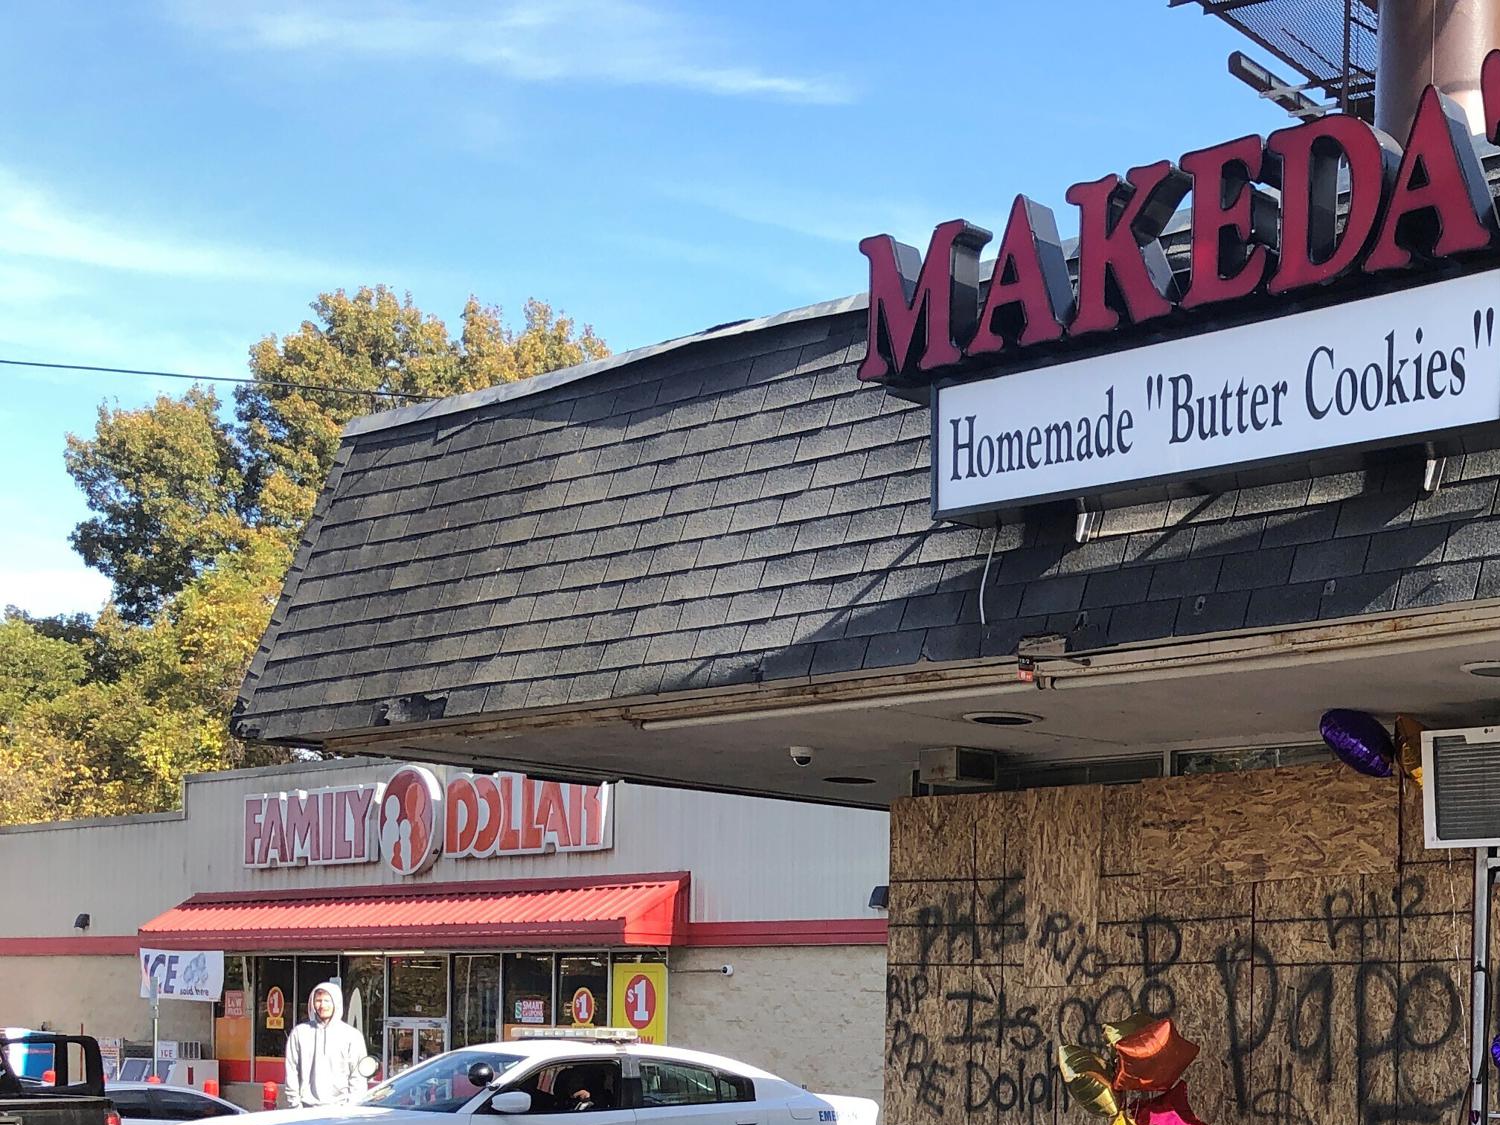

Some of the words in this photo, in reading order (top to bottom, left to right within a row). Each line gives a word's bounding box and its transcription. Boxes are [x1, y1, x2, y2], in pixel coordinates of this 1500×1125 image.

[948, 385, 1134, 483] Homemade
[1146, 374, 1289, 446] "Butter
[1304, 306, 1497, 421] Cookies"
[244, 786, 375, 866] FAMILY
[521, 1000, 544, 1009] SMART
[575, 993, 588, 1020] $1
[626, 979, 649, 1021] $1
